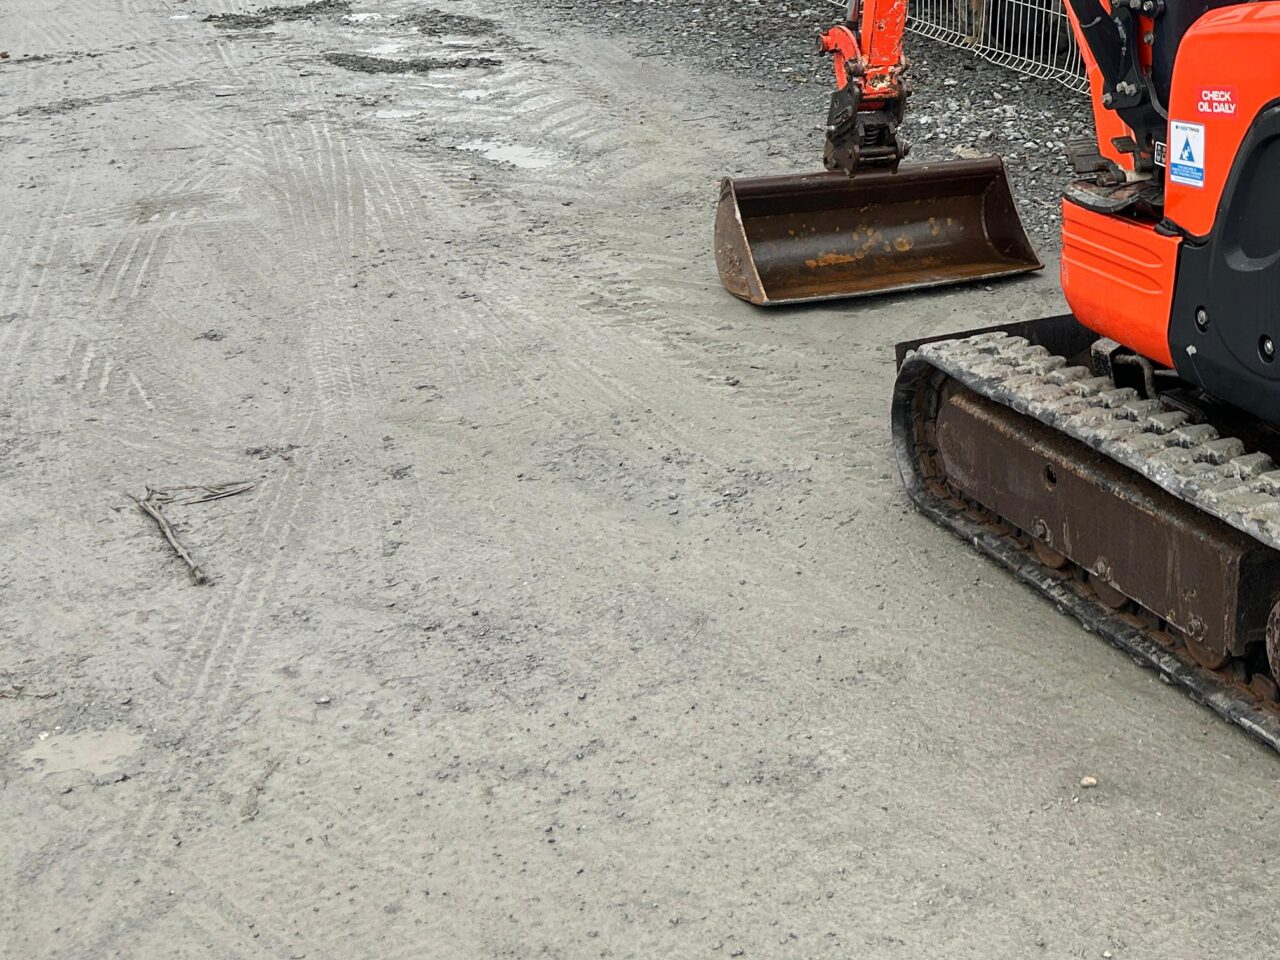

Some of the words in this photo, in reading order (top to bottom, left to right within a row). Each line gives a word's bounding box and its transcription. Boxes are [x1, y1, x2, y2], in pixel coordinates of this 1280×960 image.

[1202, 90, 1231, 101] CHECK
[1198, 102, 1212, 112] OIL
[1213, 103, 1236, 113] DAILY
